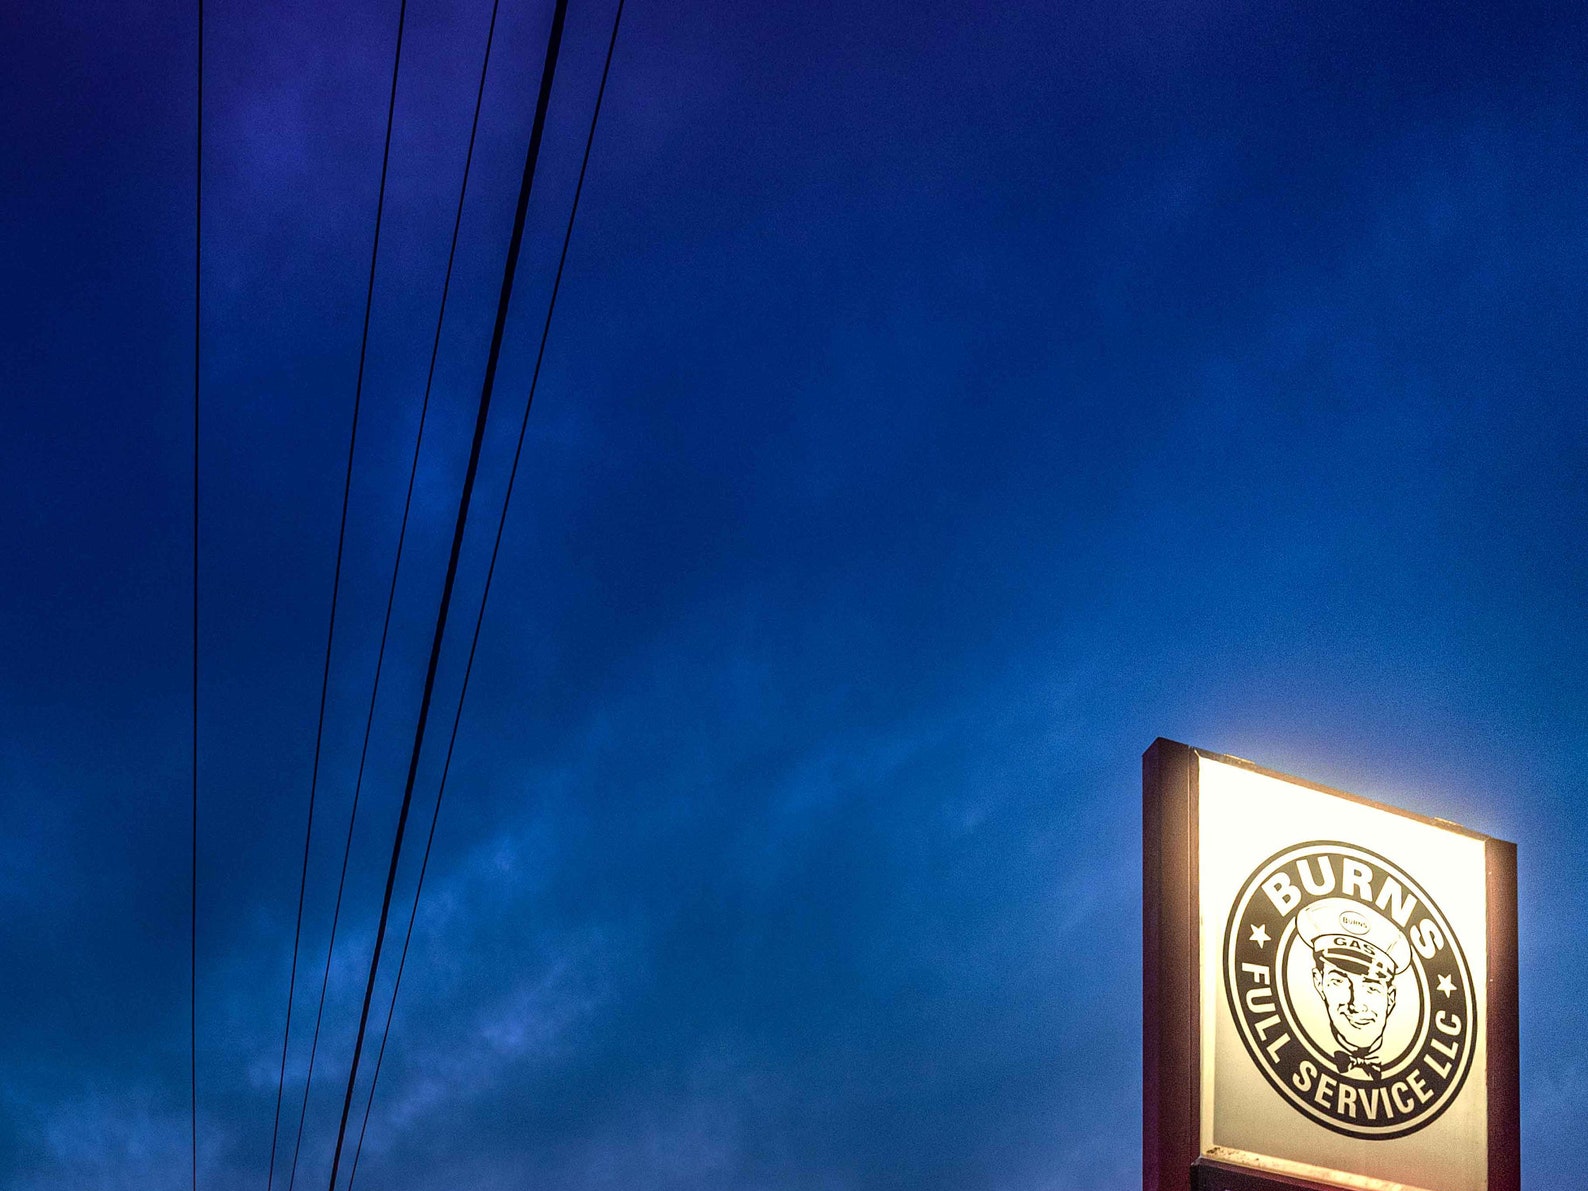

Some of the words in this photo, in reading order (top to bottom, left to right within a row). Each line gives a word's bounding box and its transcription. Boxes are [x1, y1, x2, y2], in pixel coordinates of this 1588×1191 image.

[1261, 855, 1444, 960] BURNS
[1333, 937, 1376, 955] GAS
[1241, 962, 1291, 1063] FULL
[1292, 1060, 1434, 1120] SERVICE
[1423, 1010, 1462, 1080] LLC
